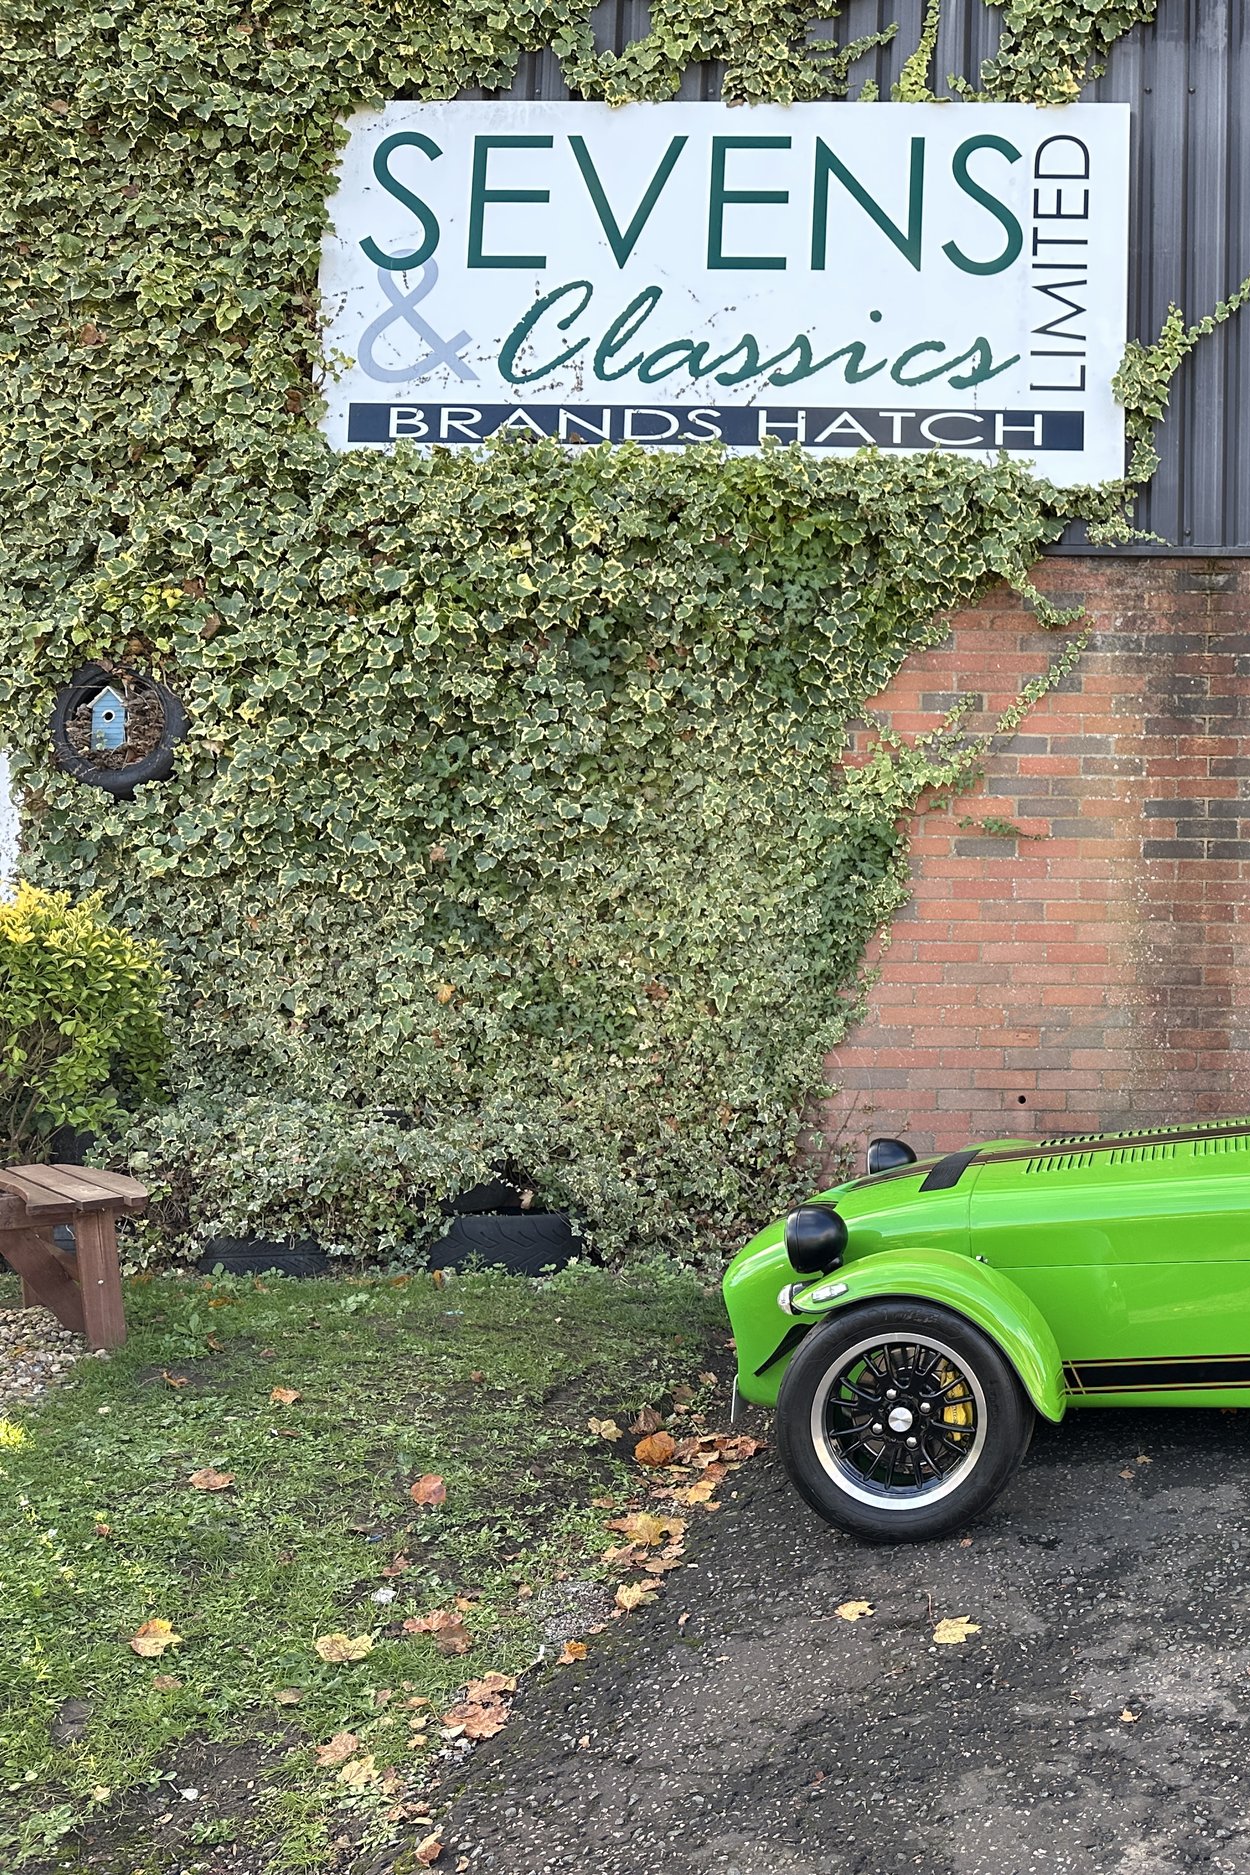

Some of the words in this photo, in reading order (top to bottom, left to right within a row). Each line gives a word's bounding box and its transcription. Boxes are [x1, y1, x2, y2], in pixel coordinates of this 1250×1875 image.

[359, 131, 1024, 275] SEVENS
[1029, 134, 1090, 391] LIMITED
[357, 249, 480, 383] &
[500, 280, 1021, 389] Classics
[388, 406, 724, 441] BRANDS
[758, 409, 1043, 446] HATCH
